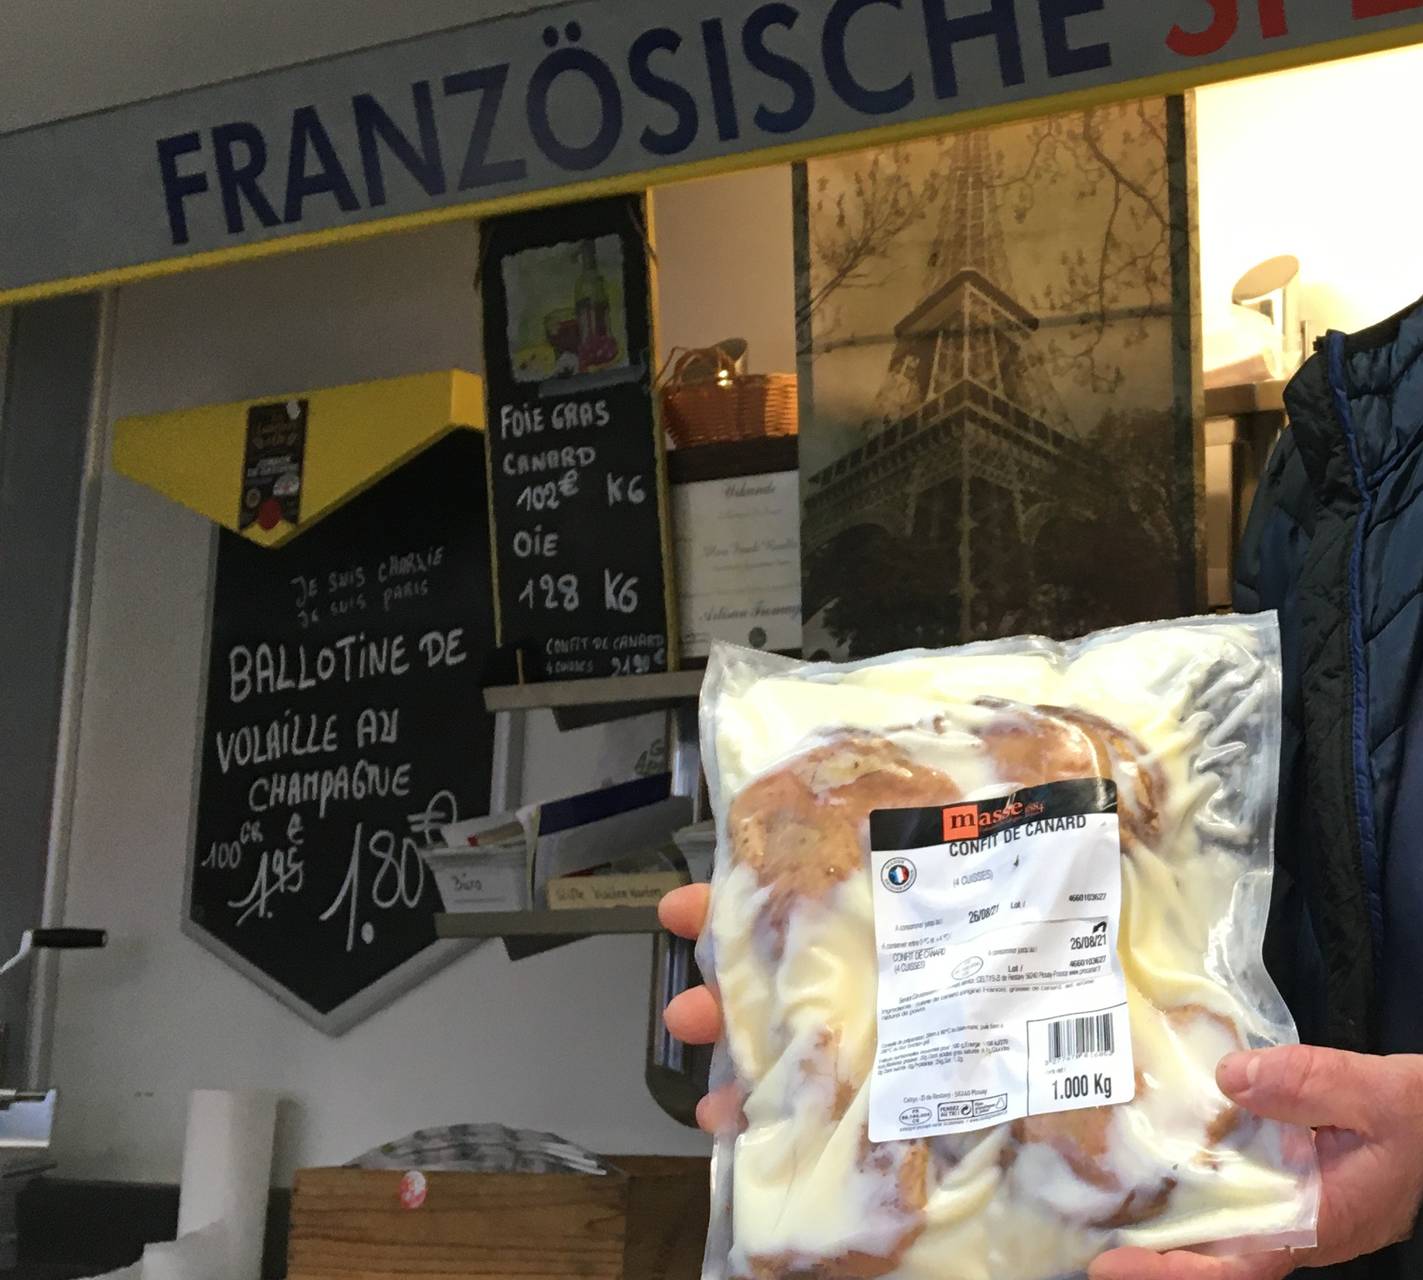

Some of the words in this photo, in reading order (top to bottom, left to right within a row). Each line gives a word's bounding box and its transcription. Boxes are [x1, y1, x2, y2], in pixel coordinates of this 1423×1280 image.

[156, 0, 1111, 244] FRANZÖSISCHE
[551, 400, 610, 430] GRAS
[503, 446, 596, 476] CANARD
[606, 472, 646, 506] KG
[518, 574, 580, 611] 128
[604, 568, 639, 613] KG
[419, 628, 467, 668] DE
[356, 707, 399, 749] AU
[248, 759, 412, 819] CHAMPAGNE
[949, 832, 999, 857] CONFIT
[1004, 828, 1021, 844] DE
[1025, 814, 1086, 837] CANARD
[1070, 933, 1107, 950] 26/08/21
[1008, 965, 1018, 973] Lot
[1052, 1074, 1088, 1100] 1.000
[1094, 1073, 1112, 1099] Kg
